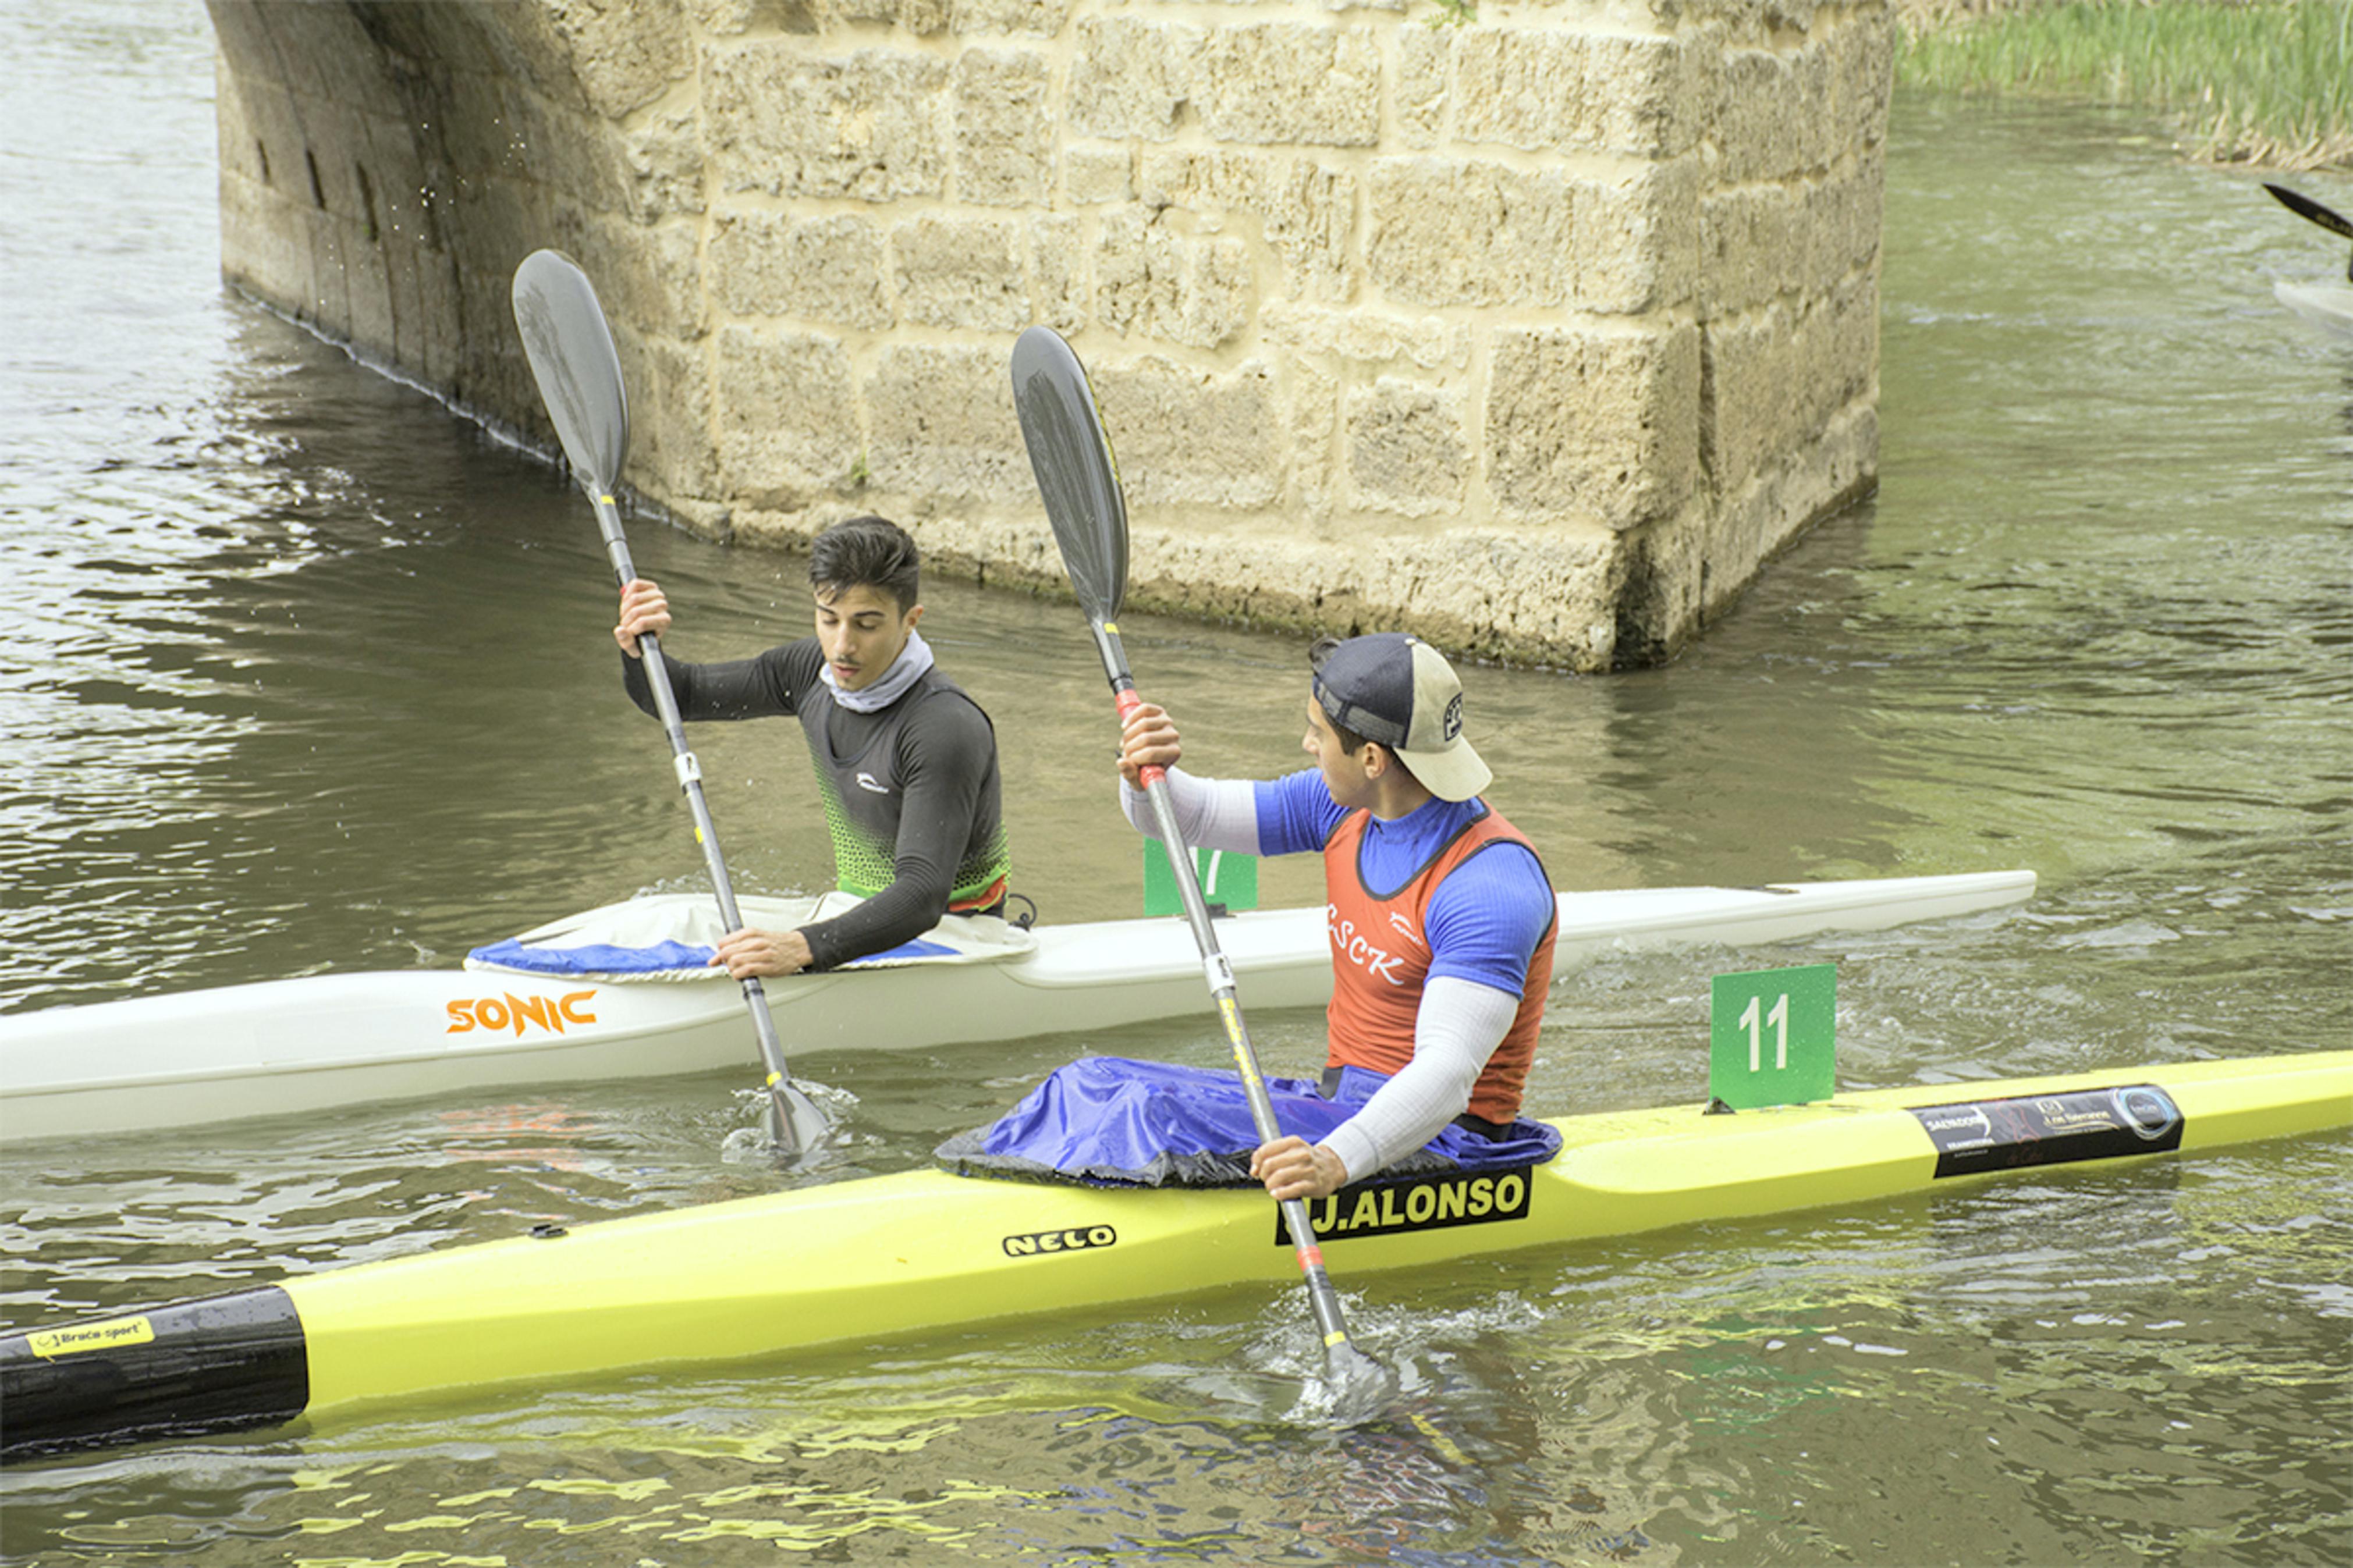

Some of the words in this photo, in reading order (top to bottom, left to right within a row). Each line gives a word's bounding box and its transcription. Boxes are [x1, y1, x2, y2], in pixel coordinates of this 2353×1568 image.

[446, 990, 598, 1038] SONIC
[1739, 993, 1788, 1072] 11
[1004, 1225, 1116, 1256] NELO
